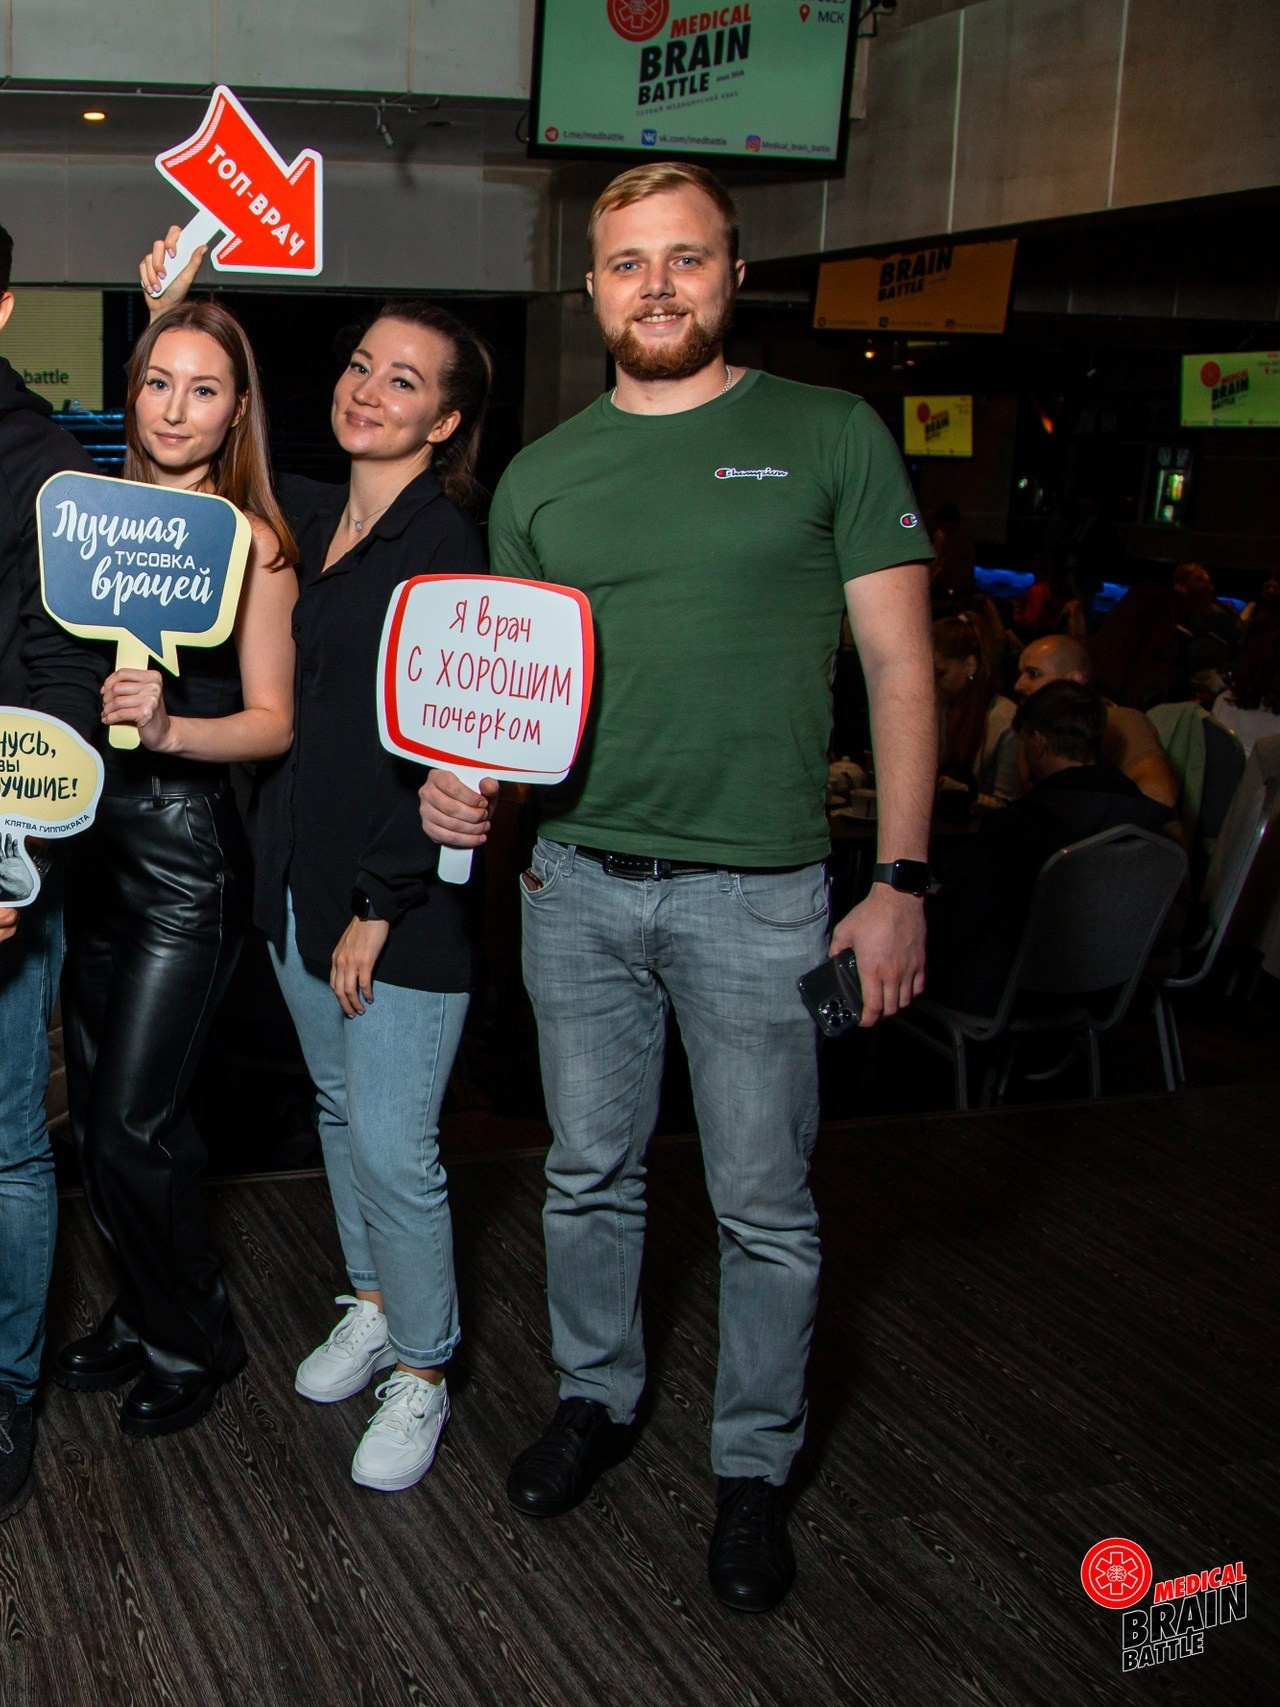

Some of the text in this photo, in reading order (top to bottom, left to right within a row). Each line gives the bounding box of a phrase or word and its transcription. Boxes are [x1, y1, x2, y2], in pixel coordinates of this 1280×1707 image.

[670, 3, 751, 38] MEDICAL
[638, 24, 751, 83] BRAIN
[637, 72, 710, 106] BATTLE
[207, 144, 306, 257] ТОП-ВРАЧ
[879, 247, 954, 288] BRAIN
[715, 467, 789, 480] Champion
[52, 500, 190, 560] Лучшая
[115, 550, 196, 570] ТУСОВКА
[91, 555, 213, 616] врачей
[449, 594, 532, 652] Я врач
[407, 645, 573, 706] С ХОРОШИМ
[422, 703, 541, 749] почерком
[4, 814, 91, 833] КЛЯТВА ГИППОКРАТА
